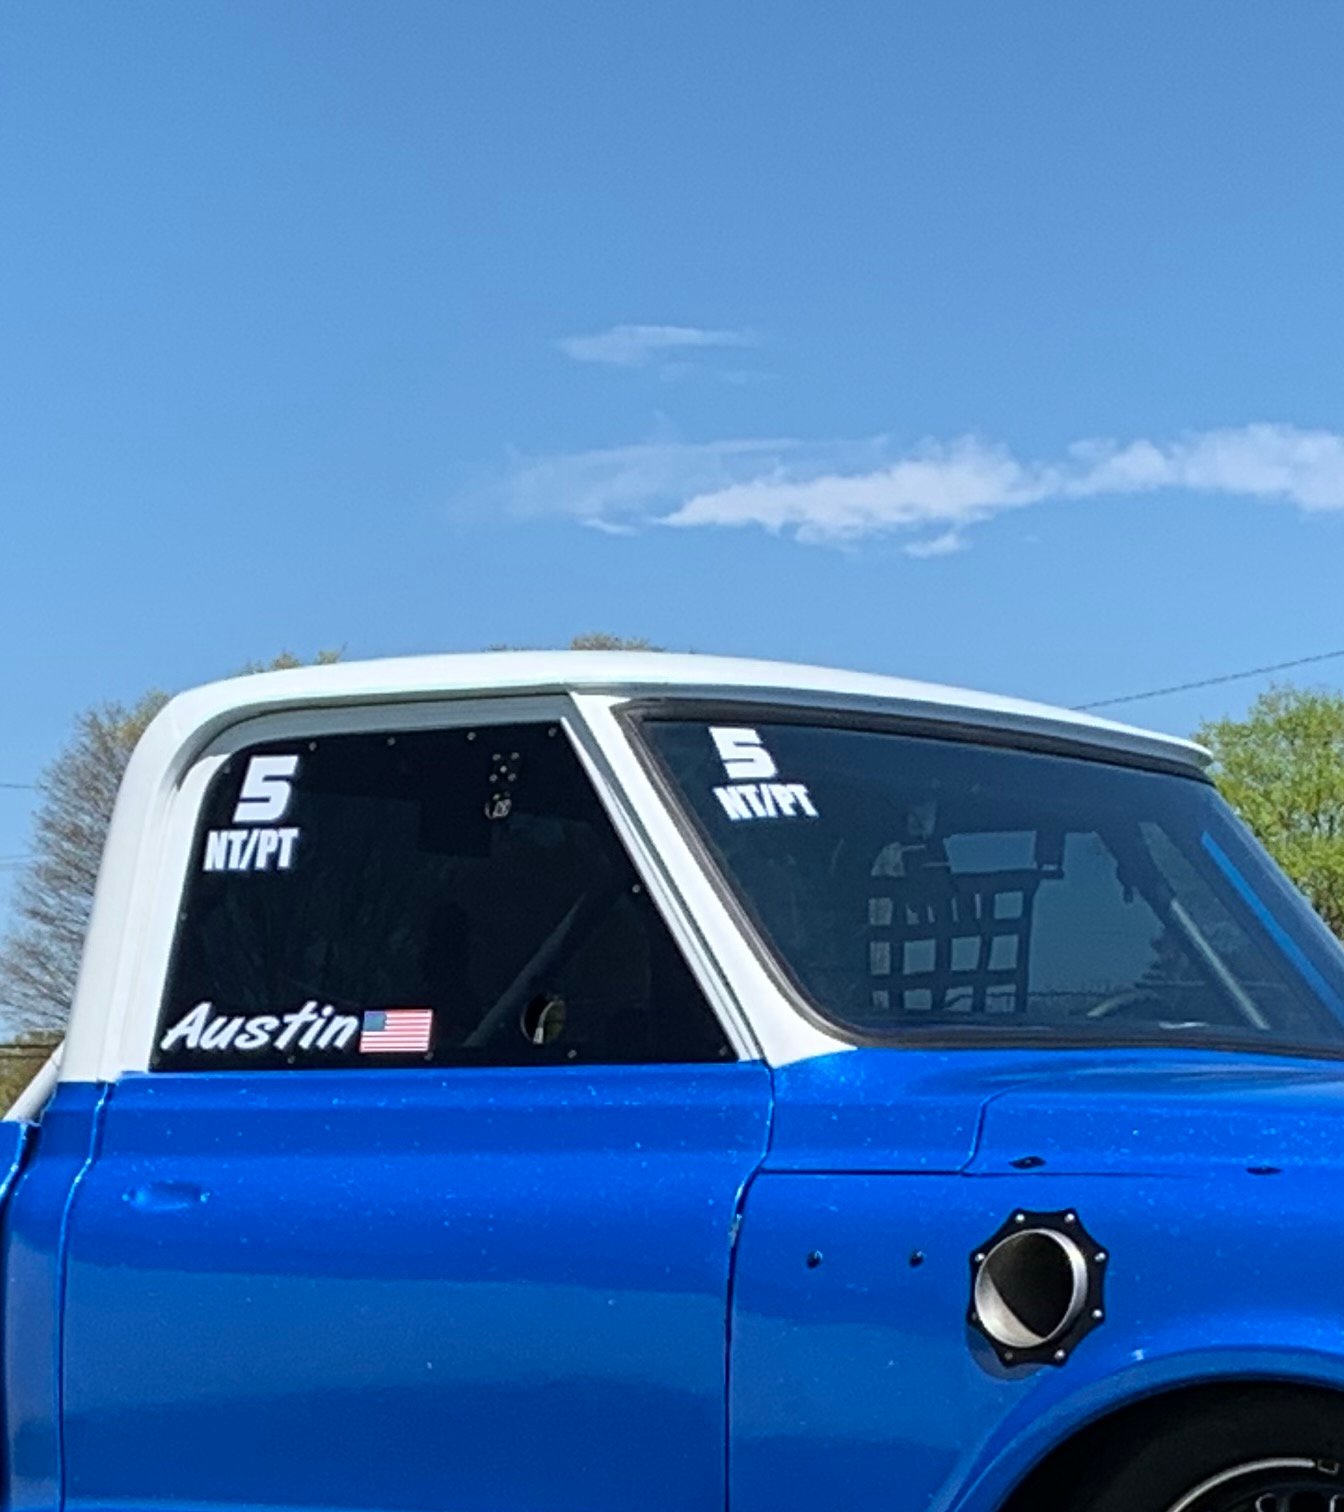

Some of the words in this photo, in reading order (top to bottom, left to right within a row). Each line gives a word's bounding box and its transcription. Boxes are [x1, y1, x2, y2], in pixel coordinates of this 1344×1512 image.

[707, 726, 778, 779] 5
[232, 755, 298, 823] 5
[713, 784, 819, 820] NT/PT
[203, 827, 299, 872] NT/PT
[160, 1001, 358, 1053] Austin
